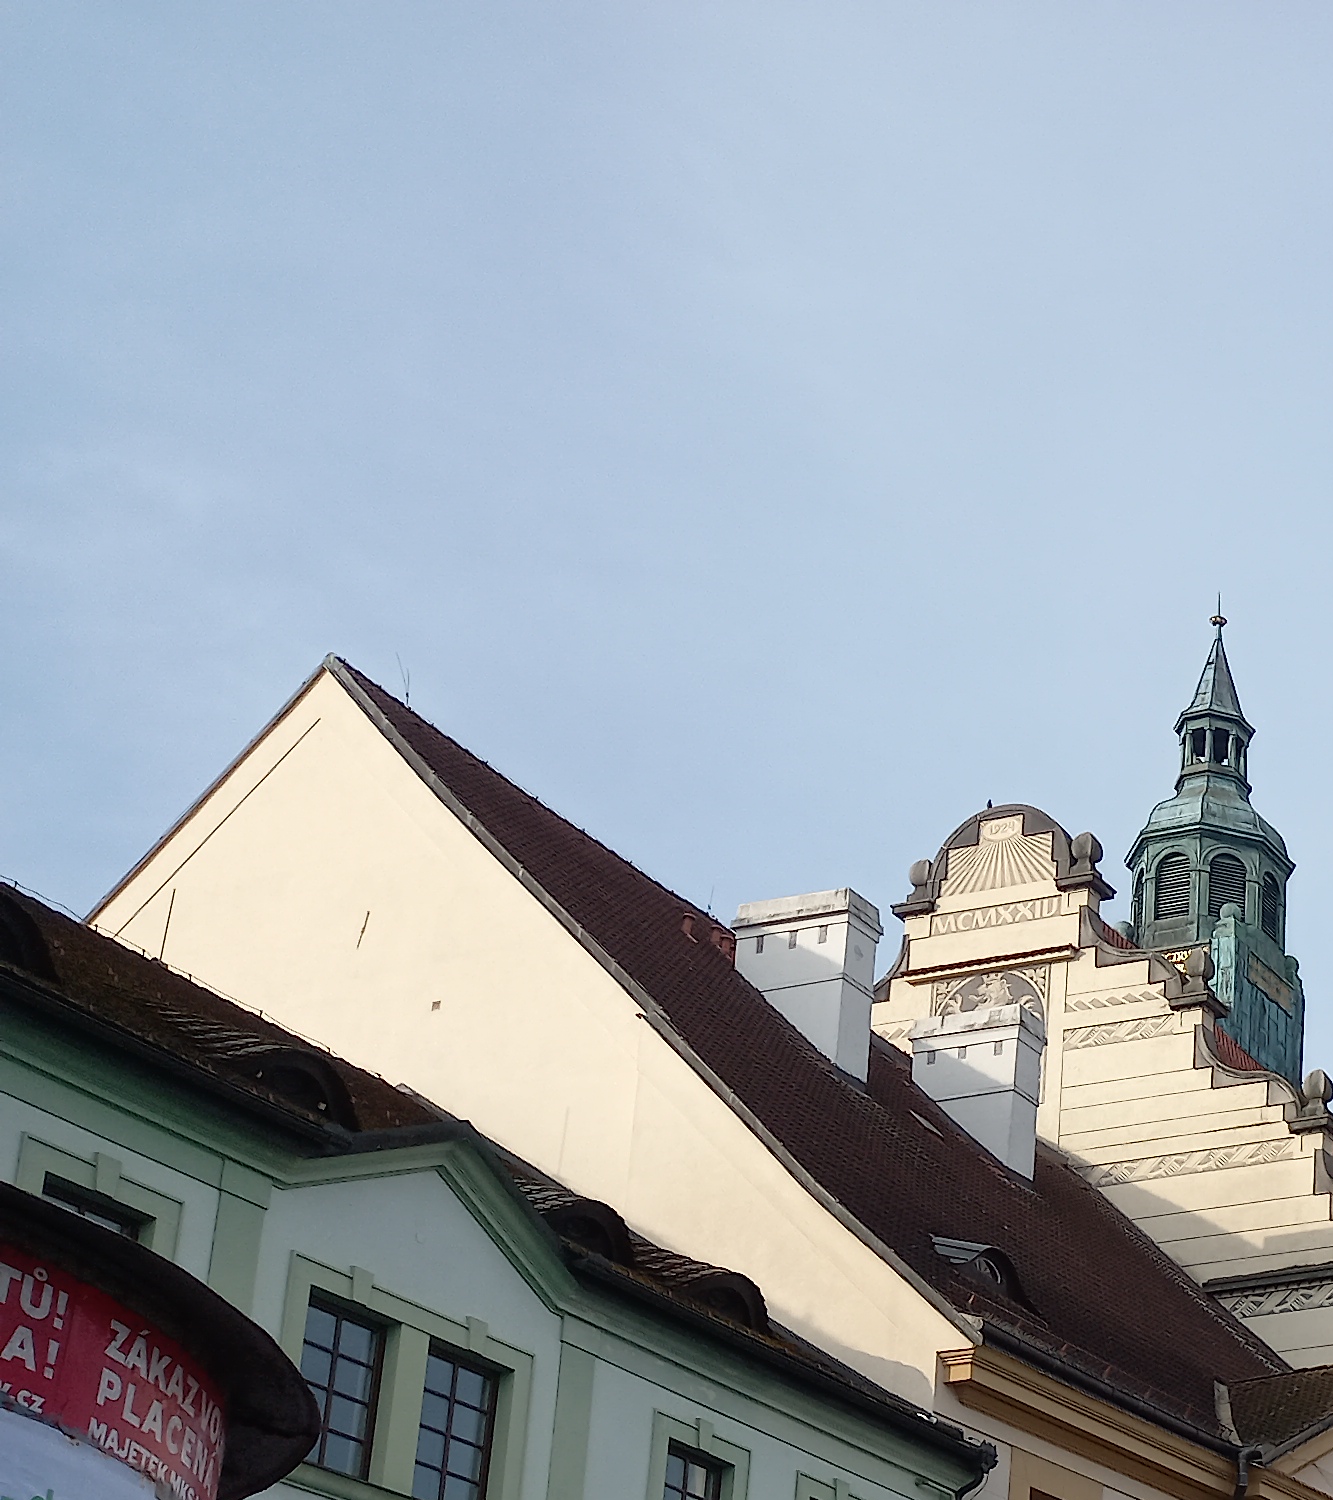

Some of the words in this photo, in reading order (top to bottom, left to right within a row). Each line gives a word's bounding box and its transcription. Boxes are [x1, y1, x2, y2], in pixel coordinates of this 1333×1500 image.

[990, 821, 1016, 835] 1924
[104, 1318, 200, 1418] ZÁKAZ
[88, 1416, 169, 1485] MAJETEK
[97, 1367, 215, 1497] PLACENÁ
